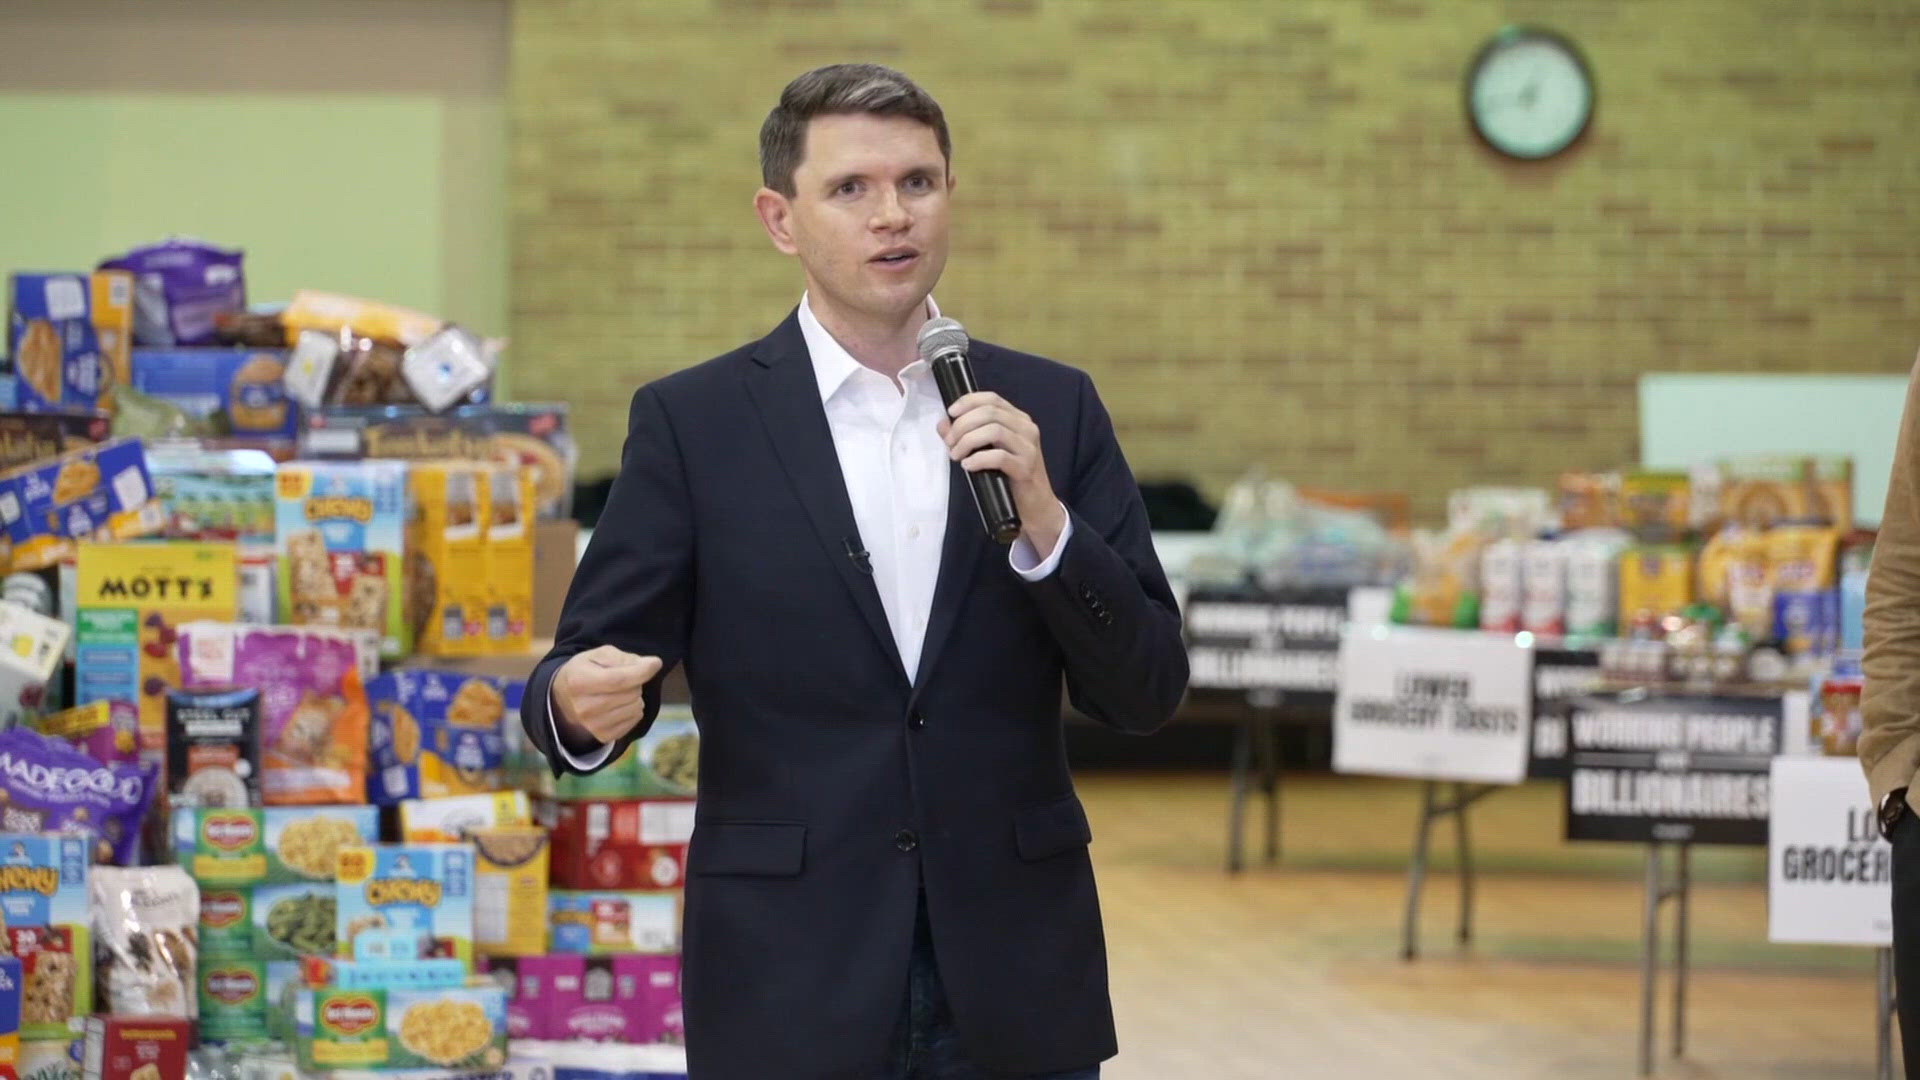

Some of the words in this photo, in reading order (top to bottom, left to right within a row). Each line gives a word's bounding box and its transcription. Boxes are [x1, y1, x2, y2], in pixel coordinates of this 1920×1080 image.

[1572, 712, 1684, 749] WORKING
[1686, 714, 1775, 752] PEOPLE
[1571, 767, 1770, 819] BILLIONAIRES
[0, 866, 59, 897] HEWY
[1784, 845, 1890, 882] GROCER
